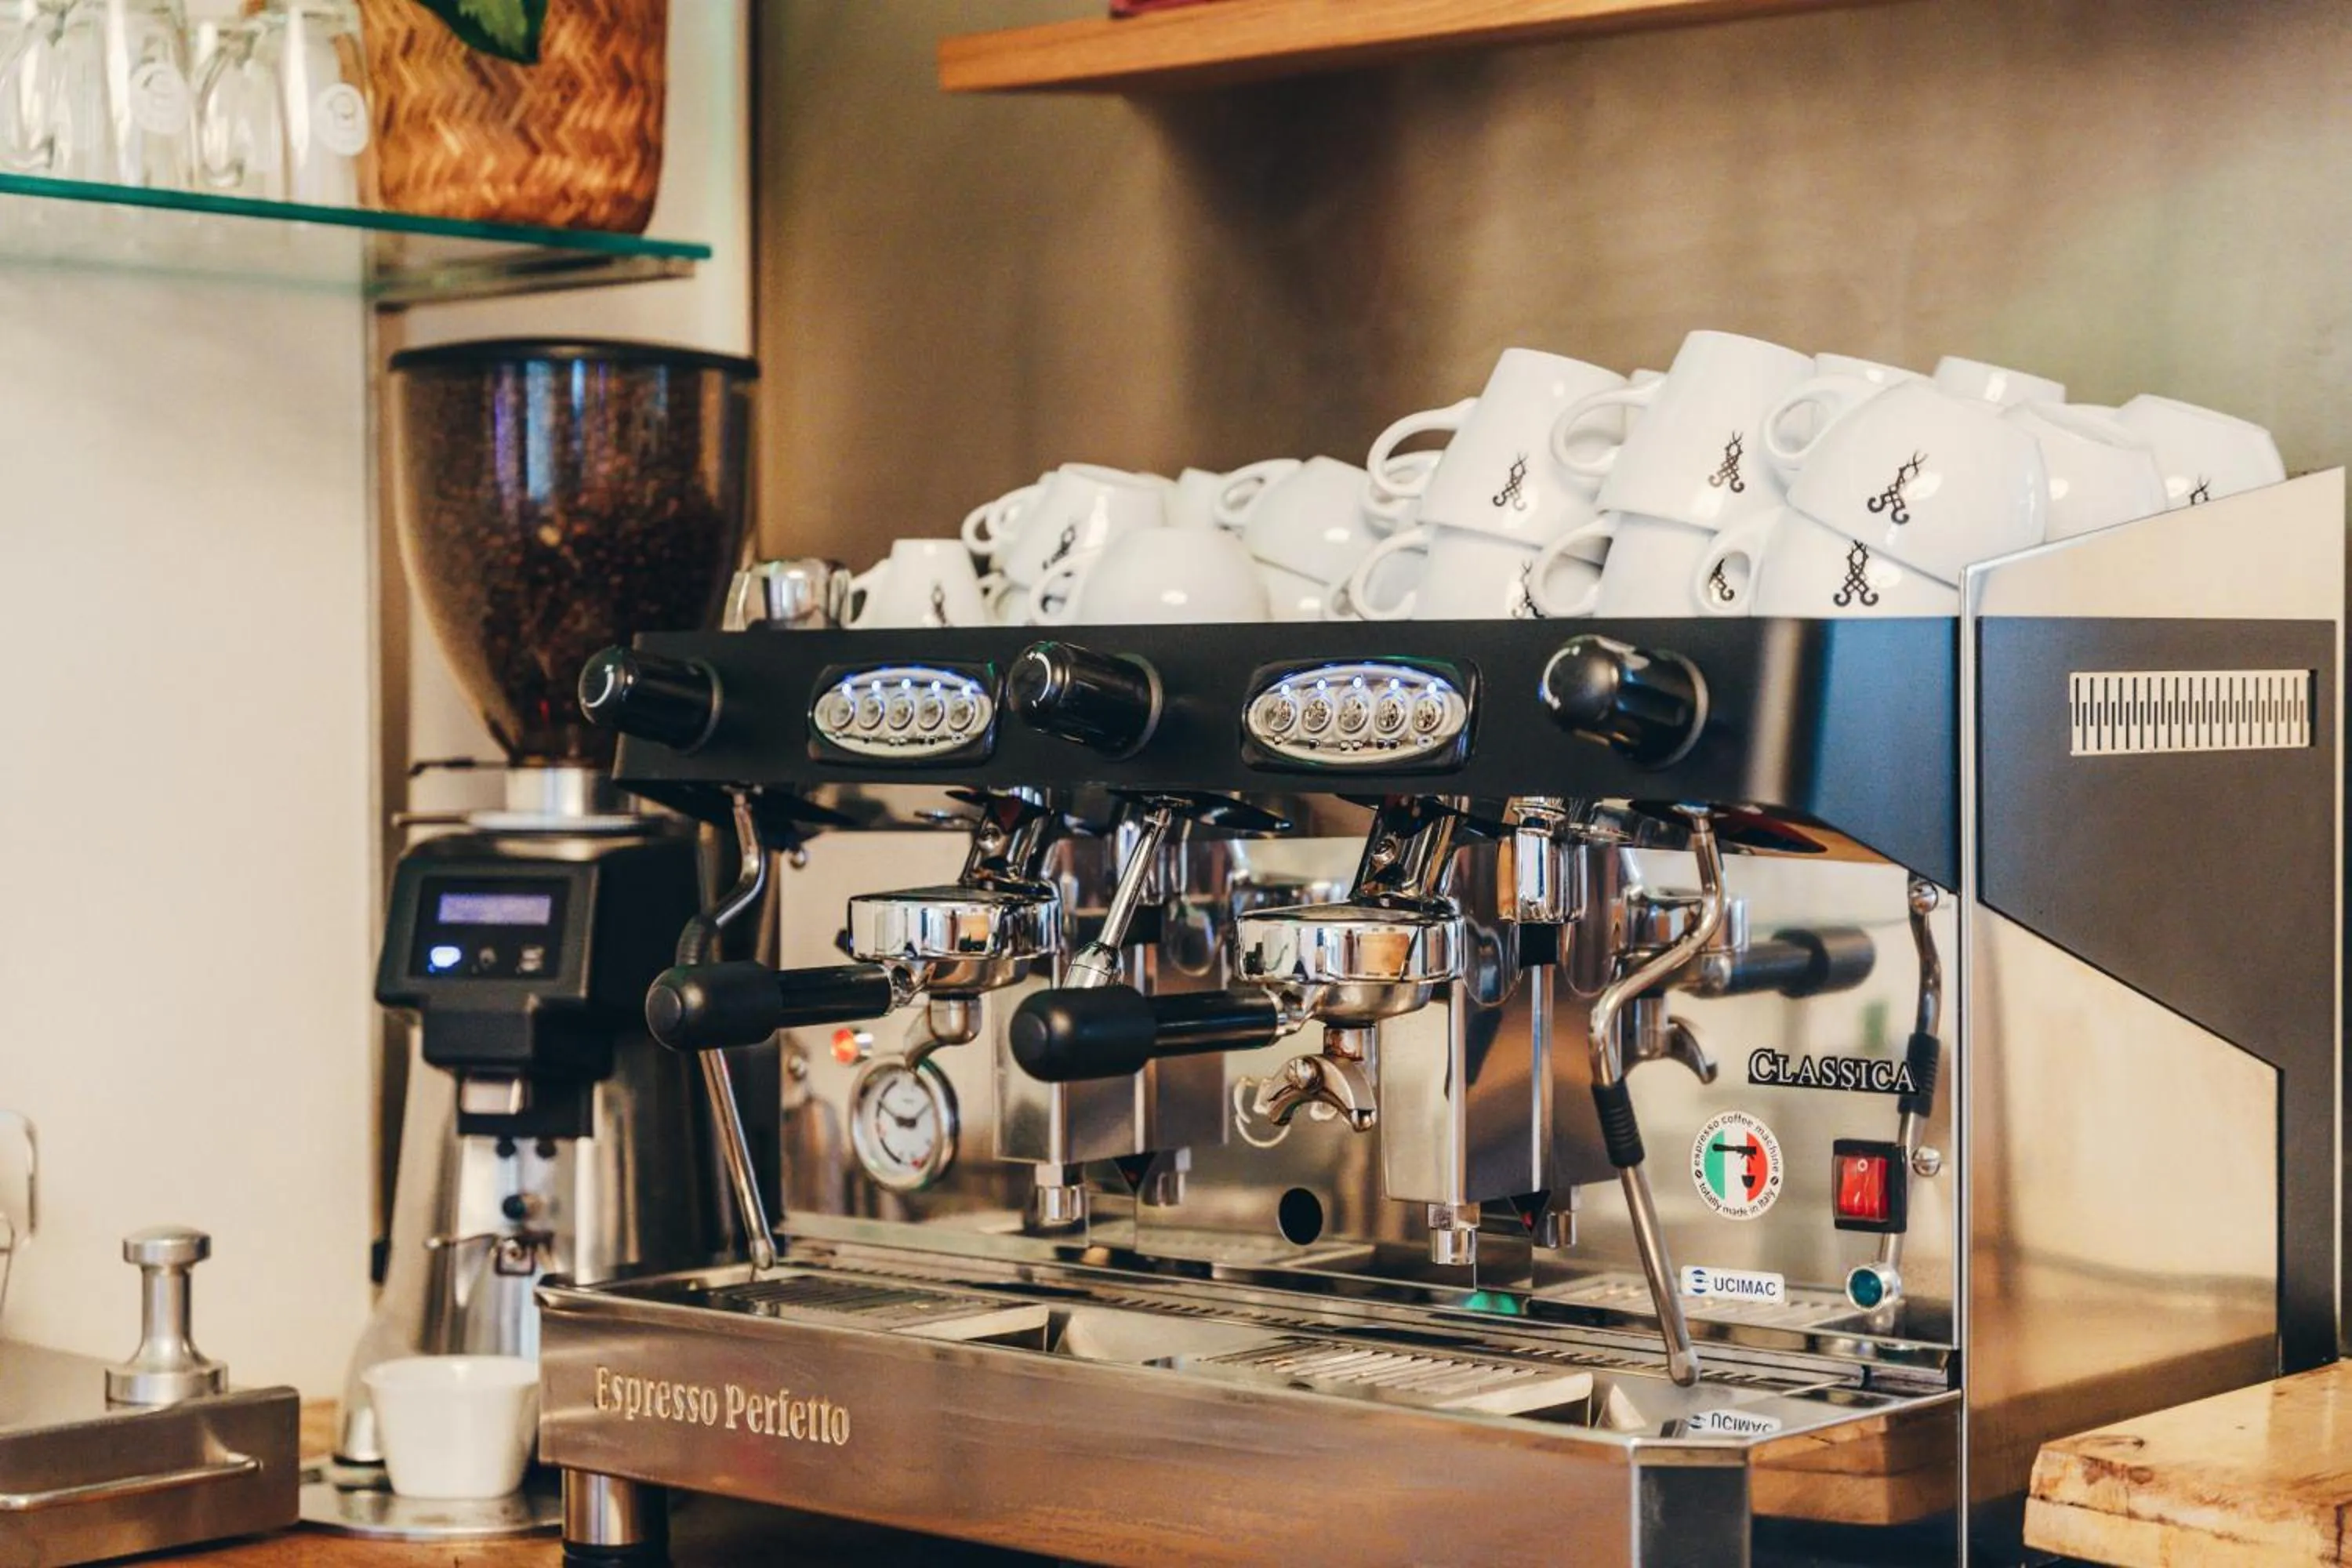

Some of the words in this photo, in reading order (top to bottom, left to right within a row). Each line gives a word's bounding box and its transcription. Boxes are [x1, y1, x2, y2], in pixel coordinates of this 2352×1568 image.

[1750, 1050, 1915, 1092] CLASSICA
[1694, 1120, 1719, 1167] espresso
[1721, 1113, 1754, 1127] coffee
[1755, 1126, 1779, 1173] machine
[1699, 1182, 1722, 1211] totally
[1722, 1207, 1748, 1216] made
[1758, 1189, 1776, 1207] Italy
[1714, 1276, 1777, 1296] UCIMAC
[595, 1366, 718, 1427] Espresso
[724, 1383, 851, 1446] Perfetto
